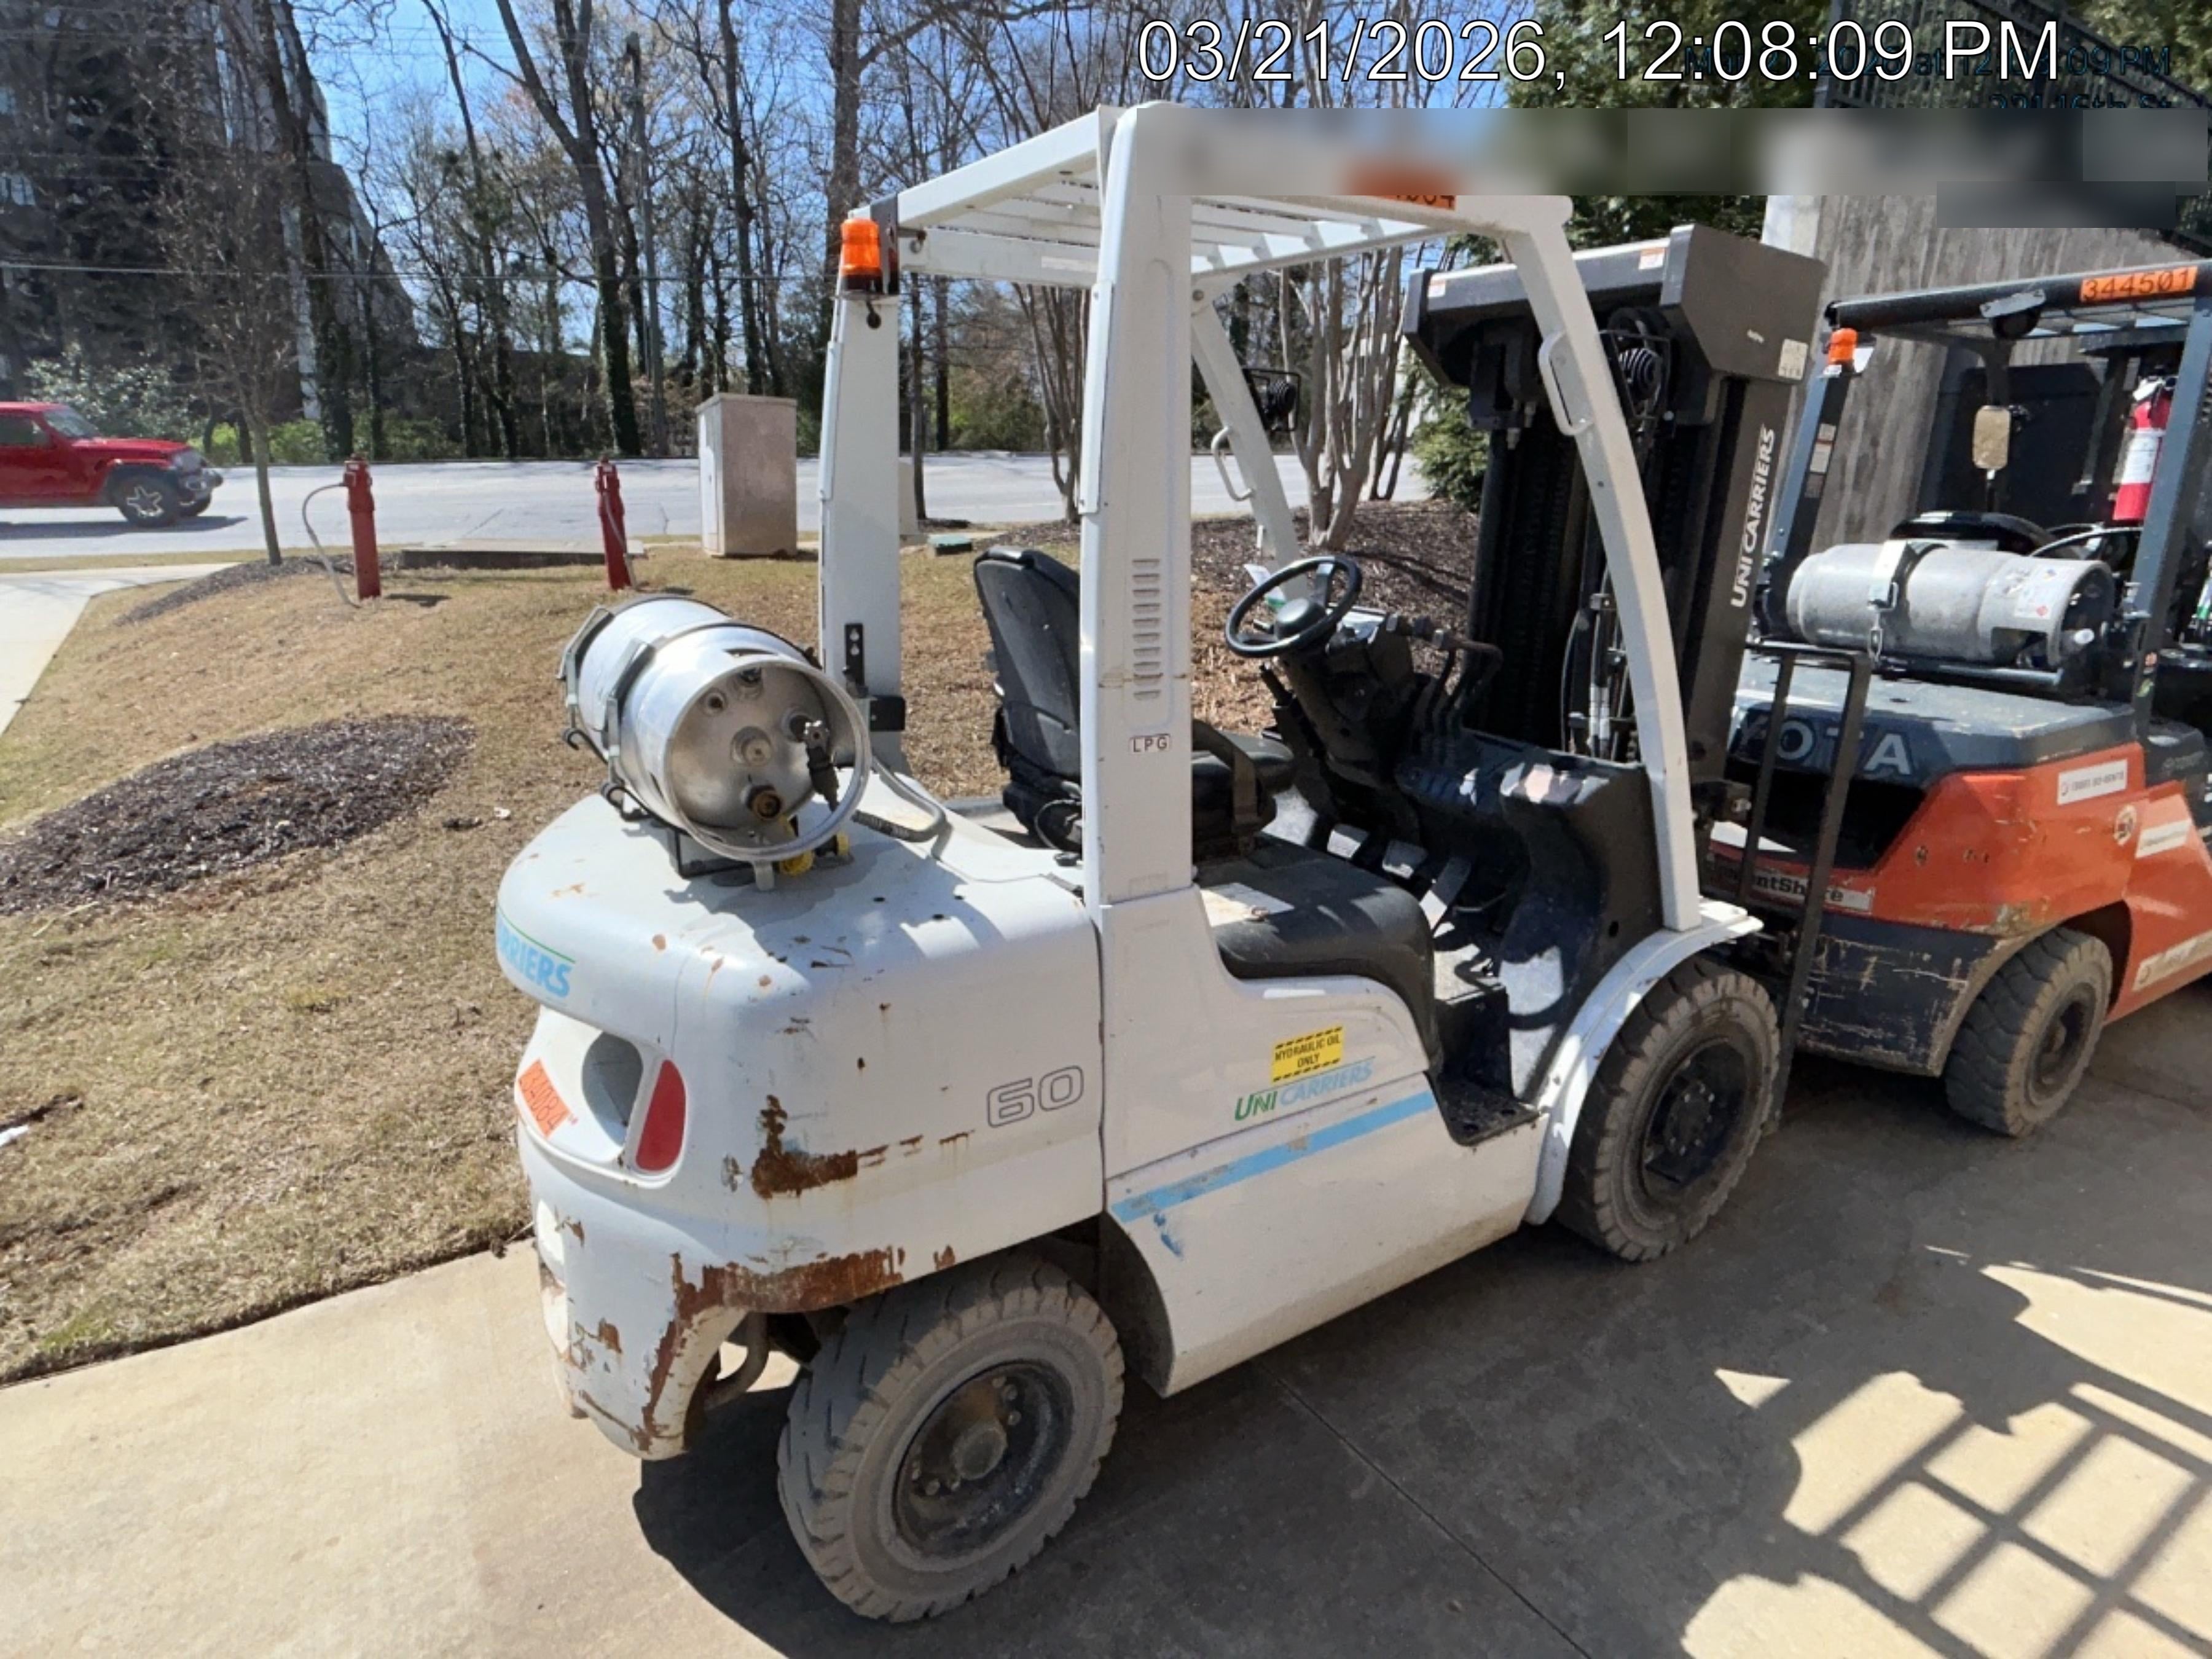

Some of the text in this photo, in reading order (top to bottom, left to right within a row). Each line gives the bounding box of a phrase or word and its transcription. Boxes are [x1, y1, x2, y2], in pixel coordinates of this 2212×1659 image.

[2084, 268, 2190, 300] 344501
[1132, 736, 1167, 753] LPG
[1327, 1033, 1341, 1045] OIL
[1298, 1053, 1320, 1067] ONLY
[987, 1065, 1084, 1128] 60
